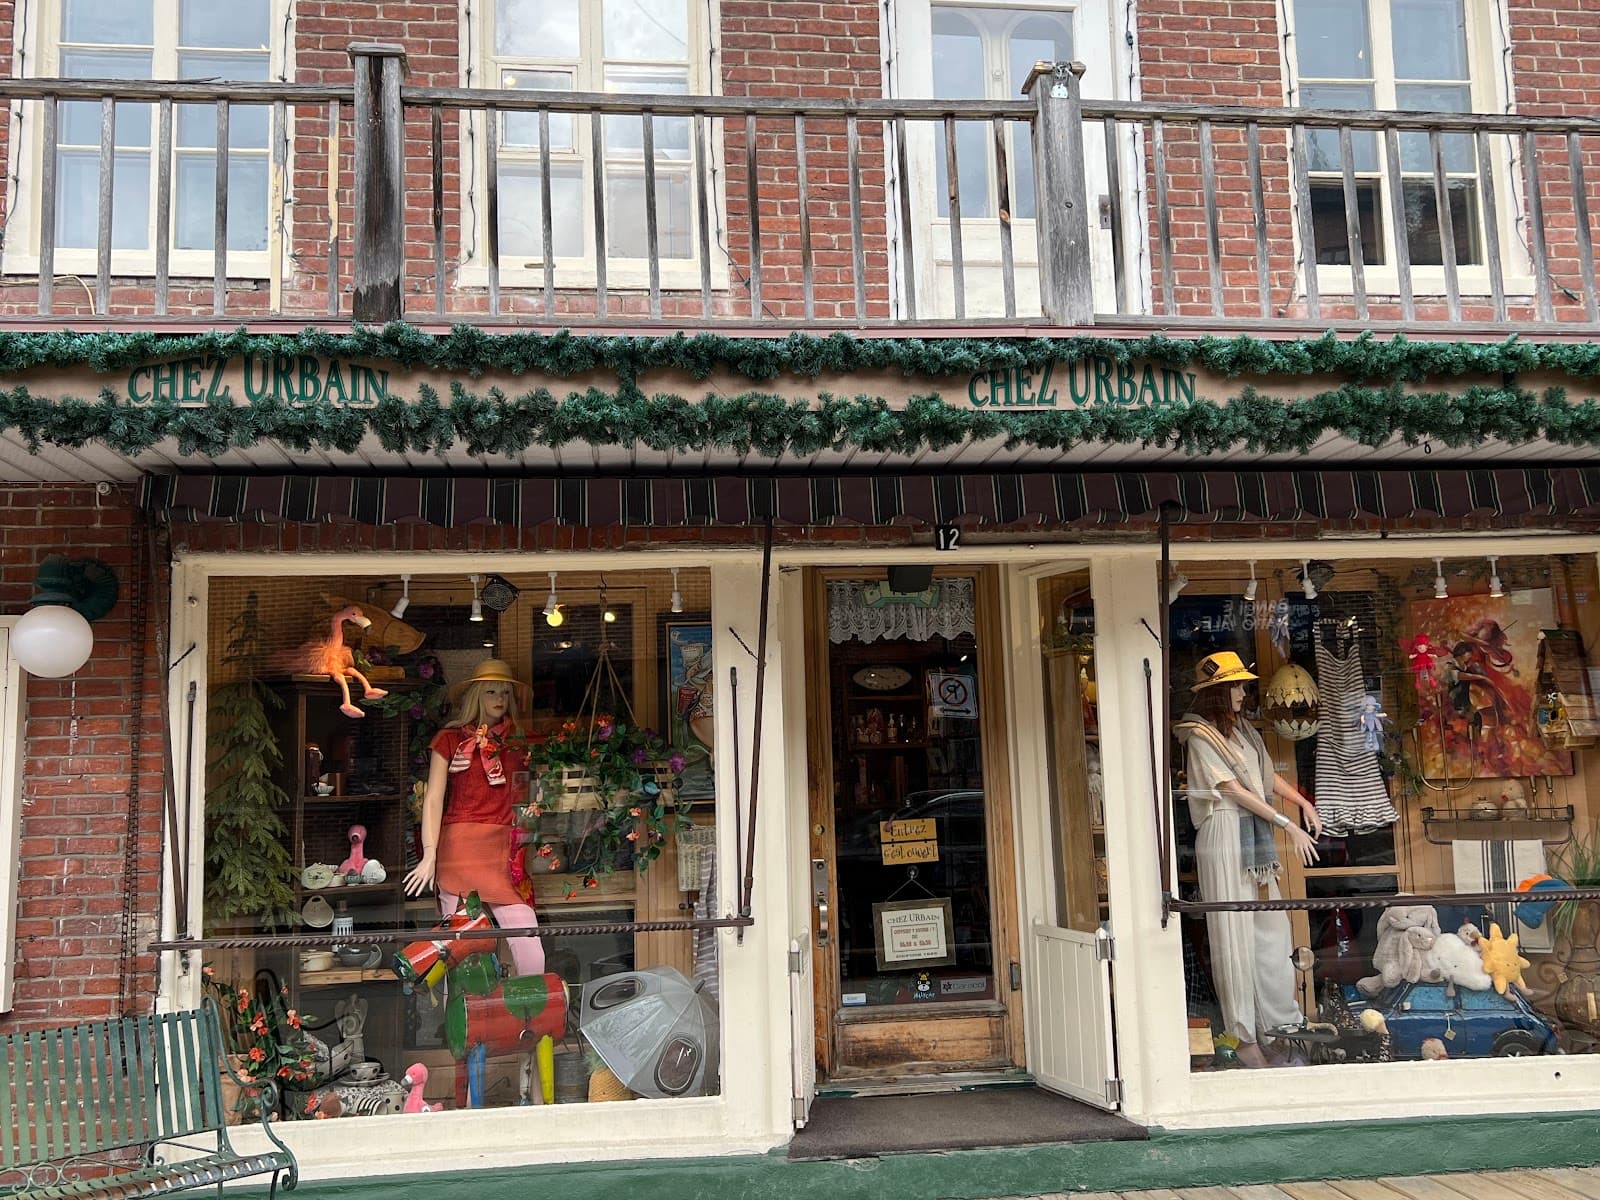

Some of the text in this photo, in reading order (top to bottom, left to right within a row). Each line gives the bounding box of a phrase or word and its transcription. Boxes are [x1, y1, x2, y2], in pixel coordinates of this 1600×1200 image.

[128, 354, 389, 405] CHEZ URBAIN
[968, 355, 1197, 407] CHEZ URBAIN
[939, 528, 960, 550] 12
[887, 913, 940, 924] CHEZ URBAIN
